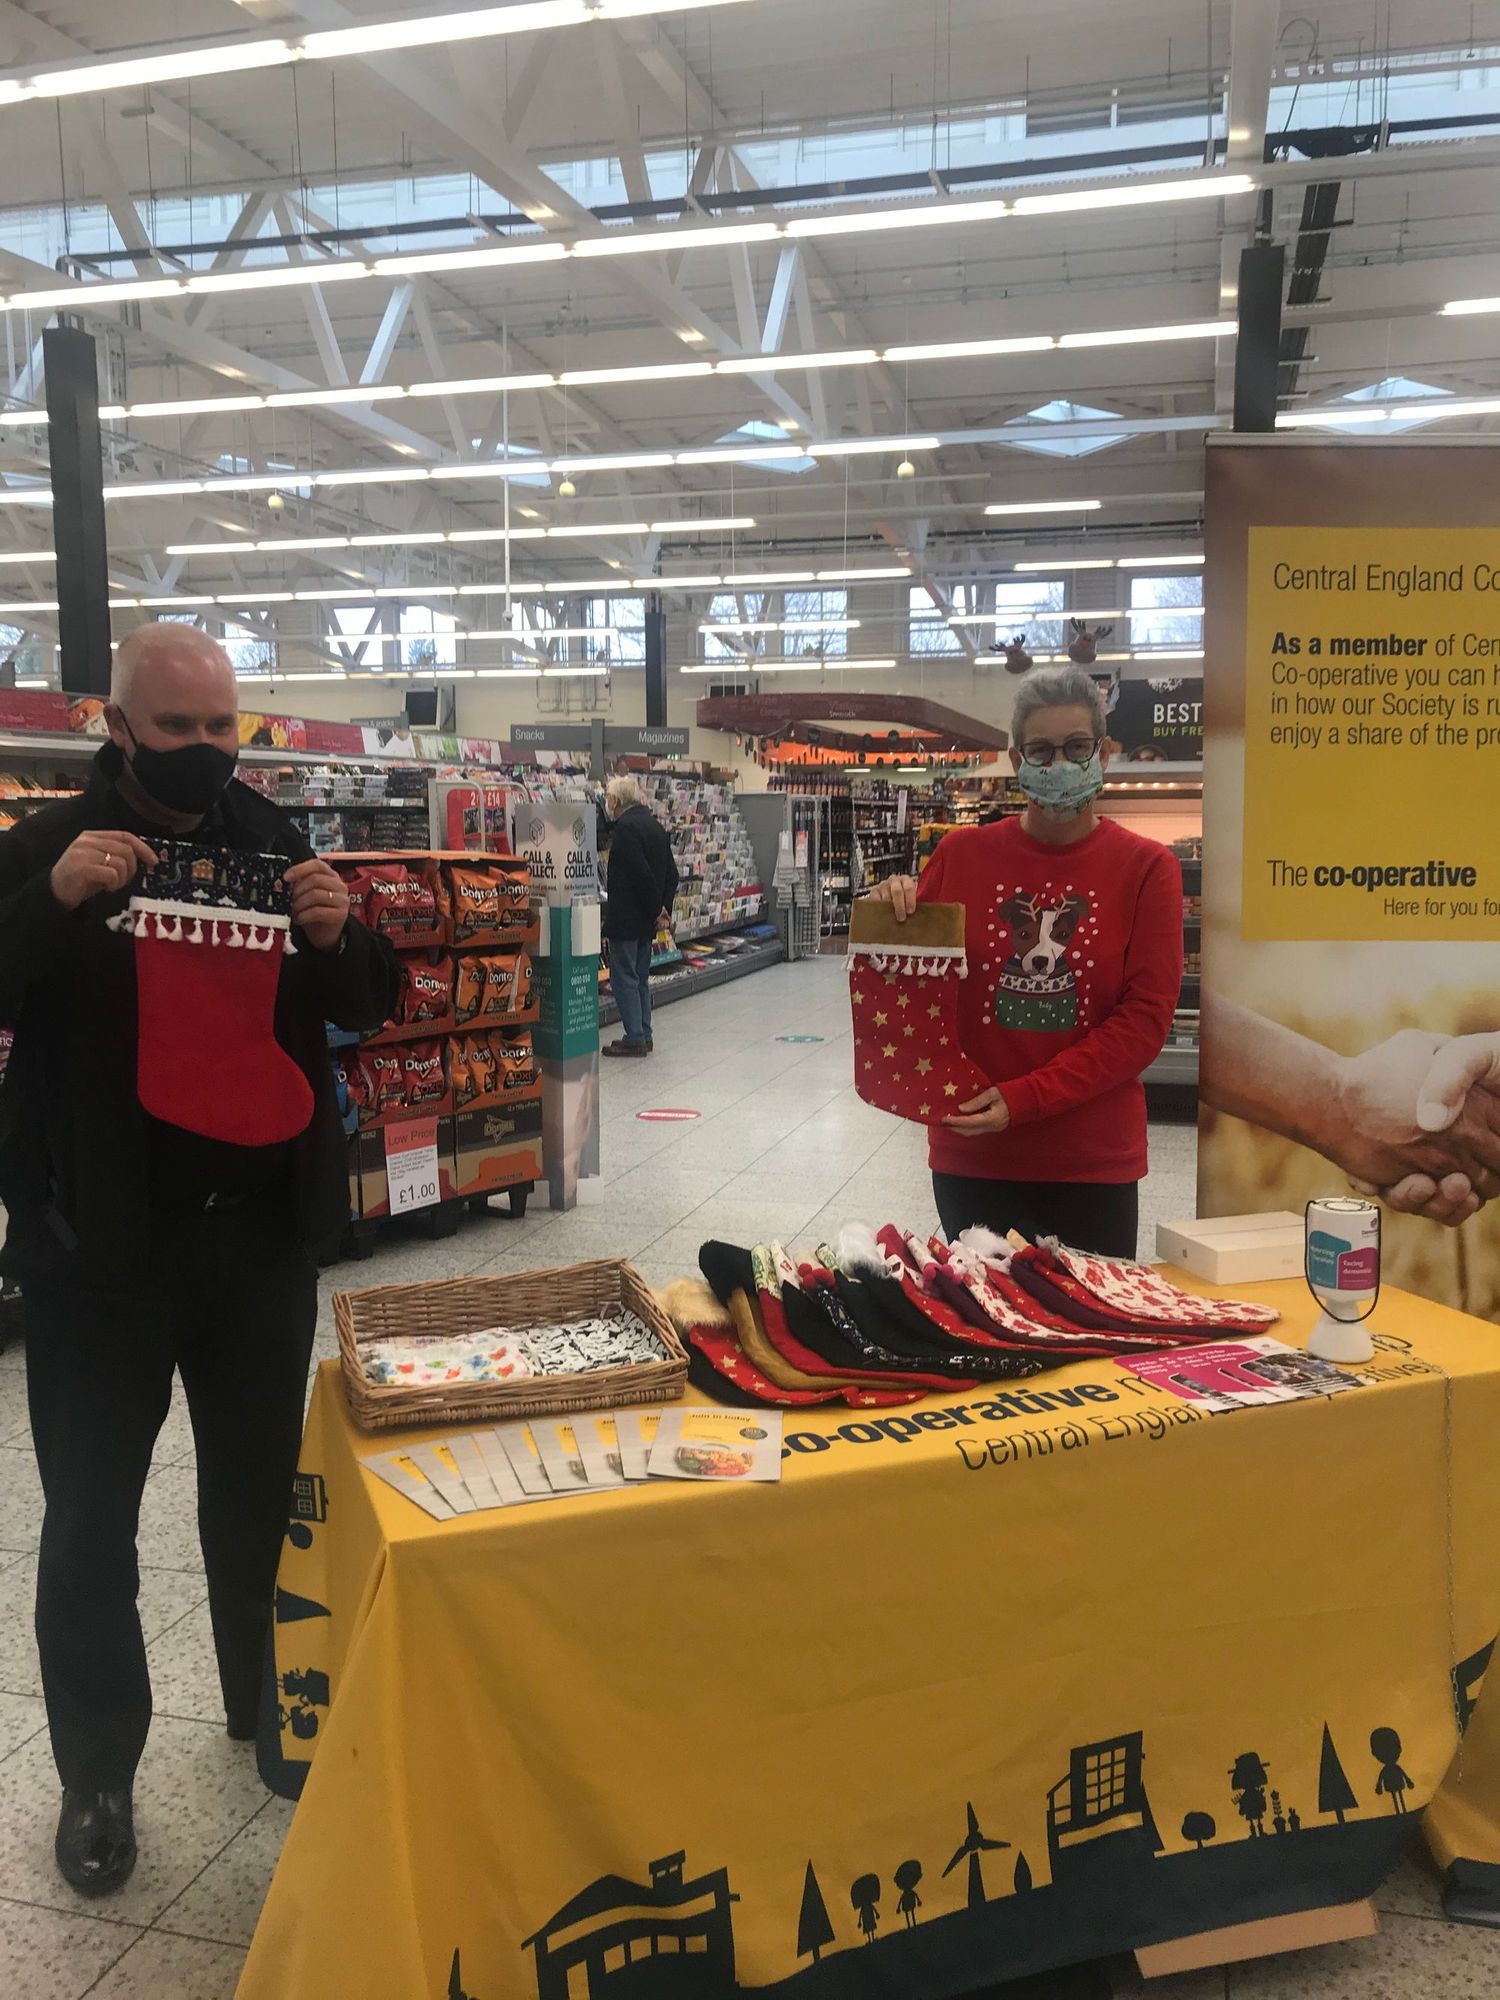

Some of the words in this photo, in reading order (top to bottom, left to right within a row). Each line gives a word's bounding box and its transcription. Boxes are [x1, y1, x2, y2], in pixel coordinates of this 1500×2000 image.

[1273, 562, 1357, 591] Central
[1366, 563, 1464, 597] England
[1271, 631, 1301, 655] As
[1308, 636, 1321, 655] a
[1329, 633, 1428, 656] member
[1435, 633, 1455, 656] of
[1272, 661, 1398, 689] Co-operative
[1405, 668, 1440, 691] you
[1448, 667, 1485, 686] can
[1153, 702, 1203, 724] BEST
[1271, 691, 1288, 714] in
[1295, 691, 1336, 715] how
[1342, 697, 1375, 715] our
[1382, 692, 1455, 720] Society
[1462, 692, 1479, 716] is
[514, 728, 545, 741] Snacks
[638, 731, 685, 745] Magazines
[1153, 726, 1177, 737] BUY
[1270, 721, 1322, 749] enjoy
[1328, 727, 1340, 745] a
[1347, 721, 1403, 745] share
[1410, 722, 1430, 745] of
[1436, 722, 1468, 745] the
[545, 850, 553, 864] &
[567, 850, 584, 864] CALL
[585, 850, 592, 864] &
[526, 865, 557, 879] OLLECT.
[564, 864, 595, 879] COLLECT.
[1266, 859, 1308, 887] The
[1313, 861, 1477, 892] co-operative
[1383, 897, 1420, 916] Here
[1424, 897, 1447, 916] for
[1450, 901, 1478, 919] you
[388, 1134, 408, 1146] Low
[410, 1128, 435, 1142] Price
[399, 1182, 436, 1204] £1.00
[781, 1384, 1119, 1459] o-operative
[955, 1421, 1089, 1471] Central
